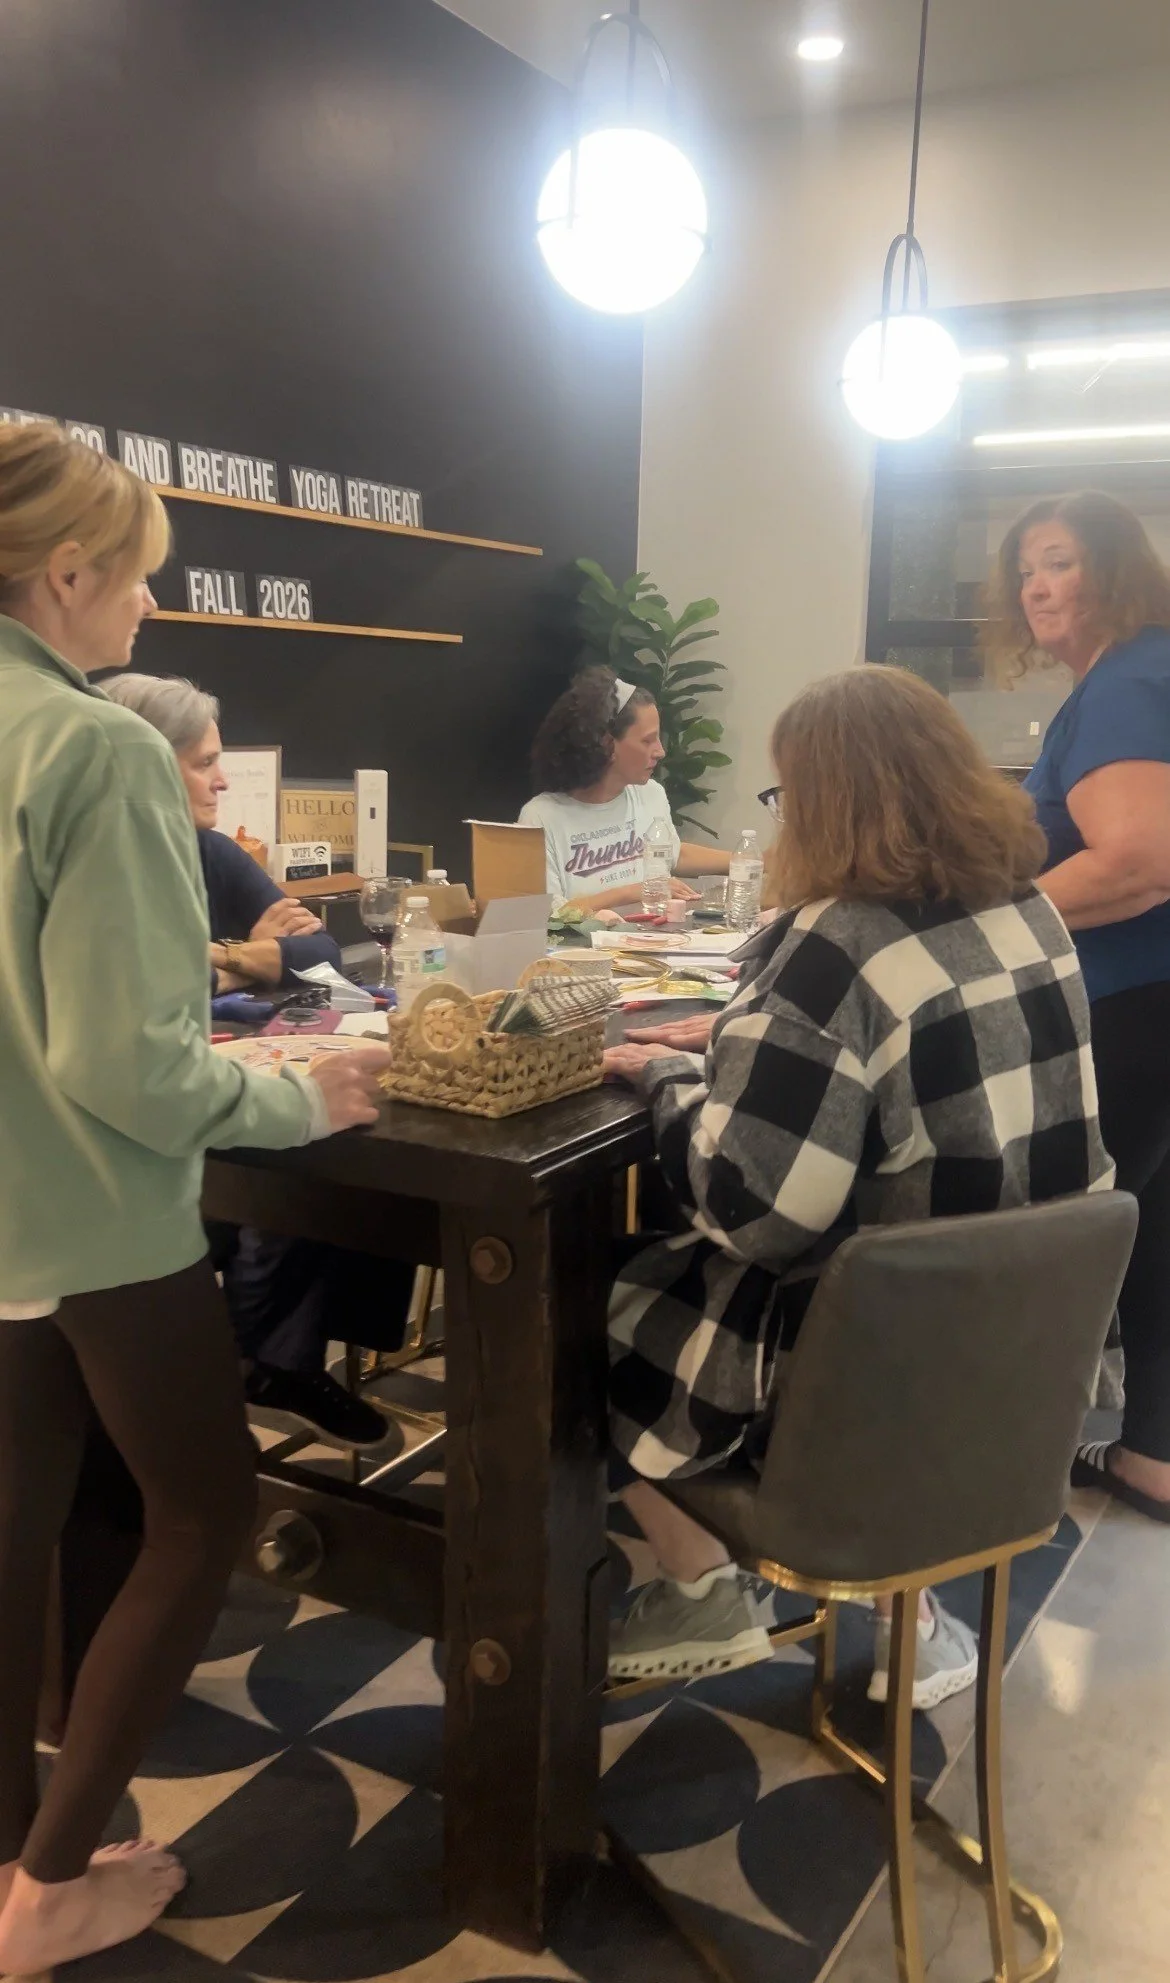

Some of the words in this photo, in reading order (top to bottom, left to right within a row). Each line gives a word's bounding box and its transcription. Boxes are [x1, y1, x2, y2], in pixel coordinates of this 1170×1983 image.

[124, 436, 170, 485] AND
[182, 447, 277, 504] BREATHE
[291, 468, 342, 516] YOGA
[347, 480, 420, 528] RETREAT
[189, 571, 244, 616] FALL
[259, 579, 311, 621] 2026
[286, 799, 355, 815] HELLO
